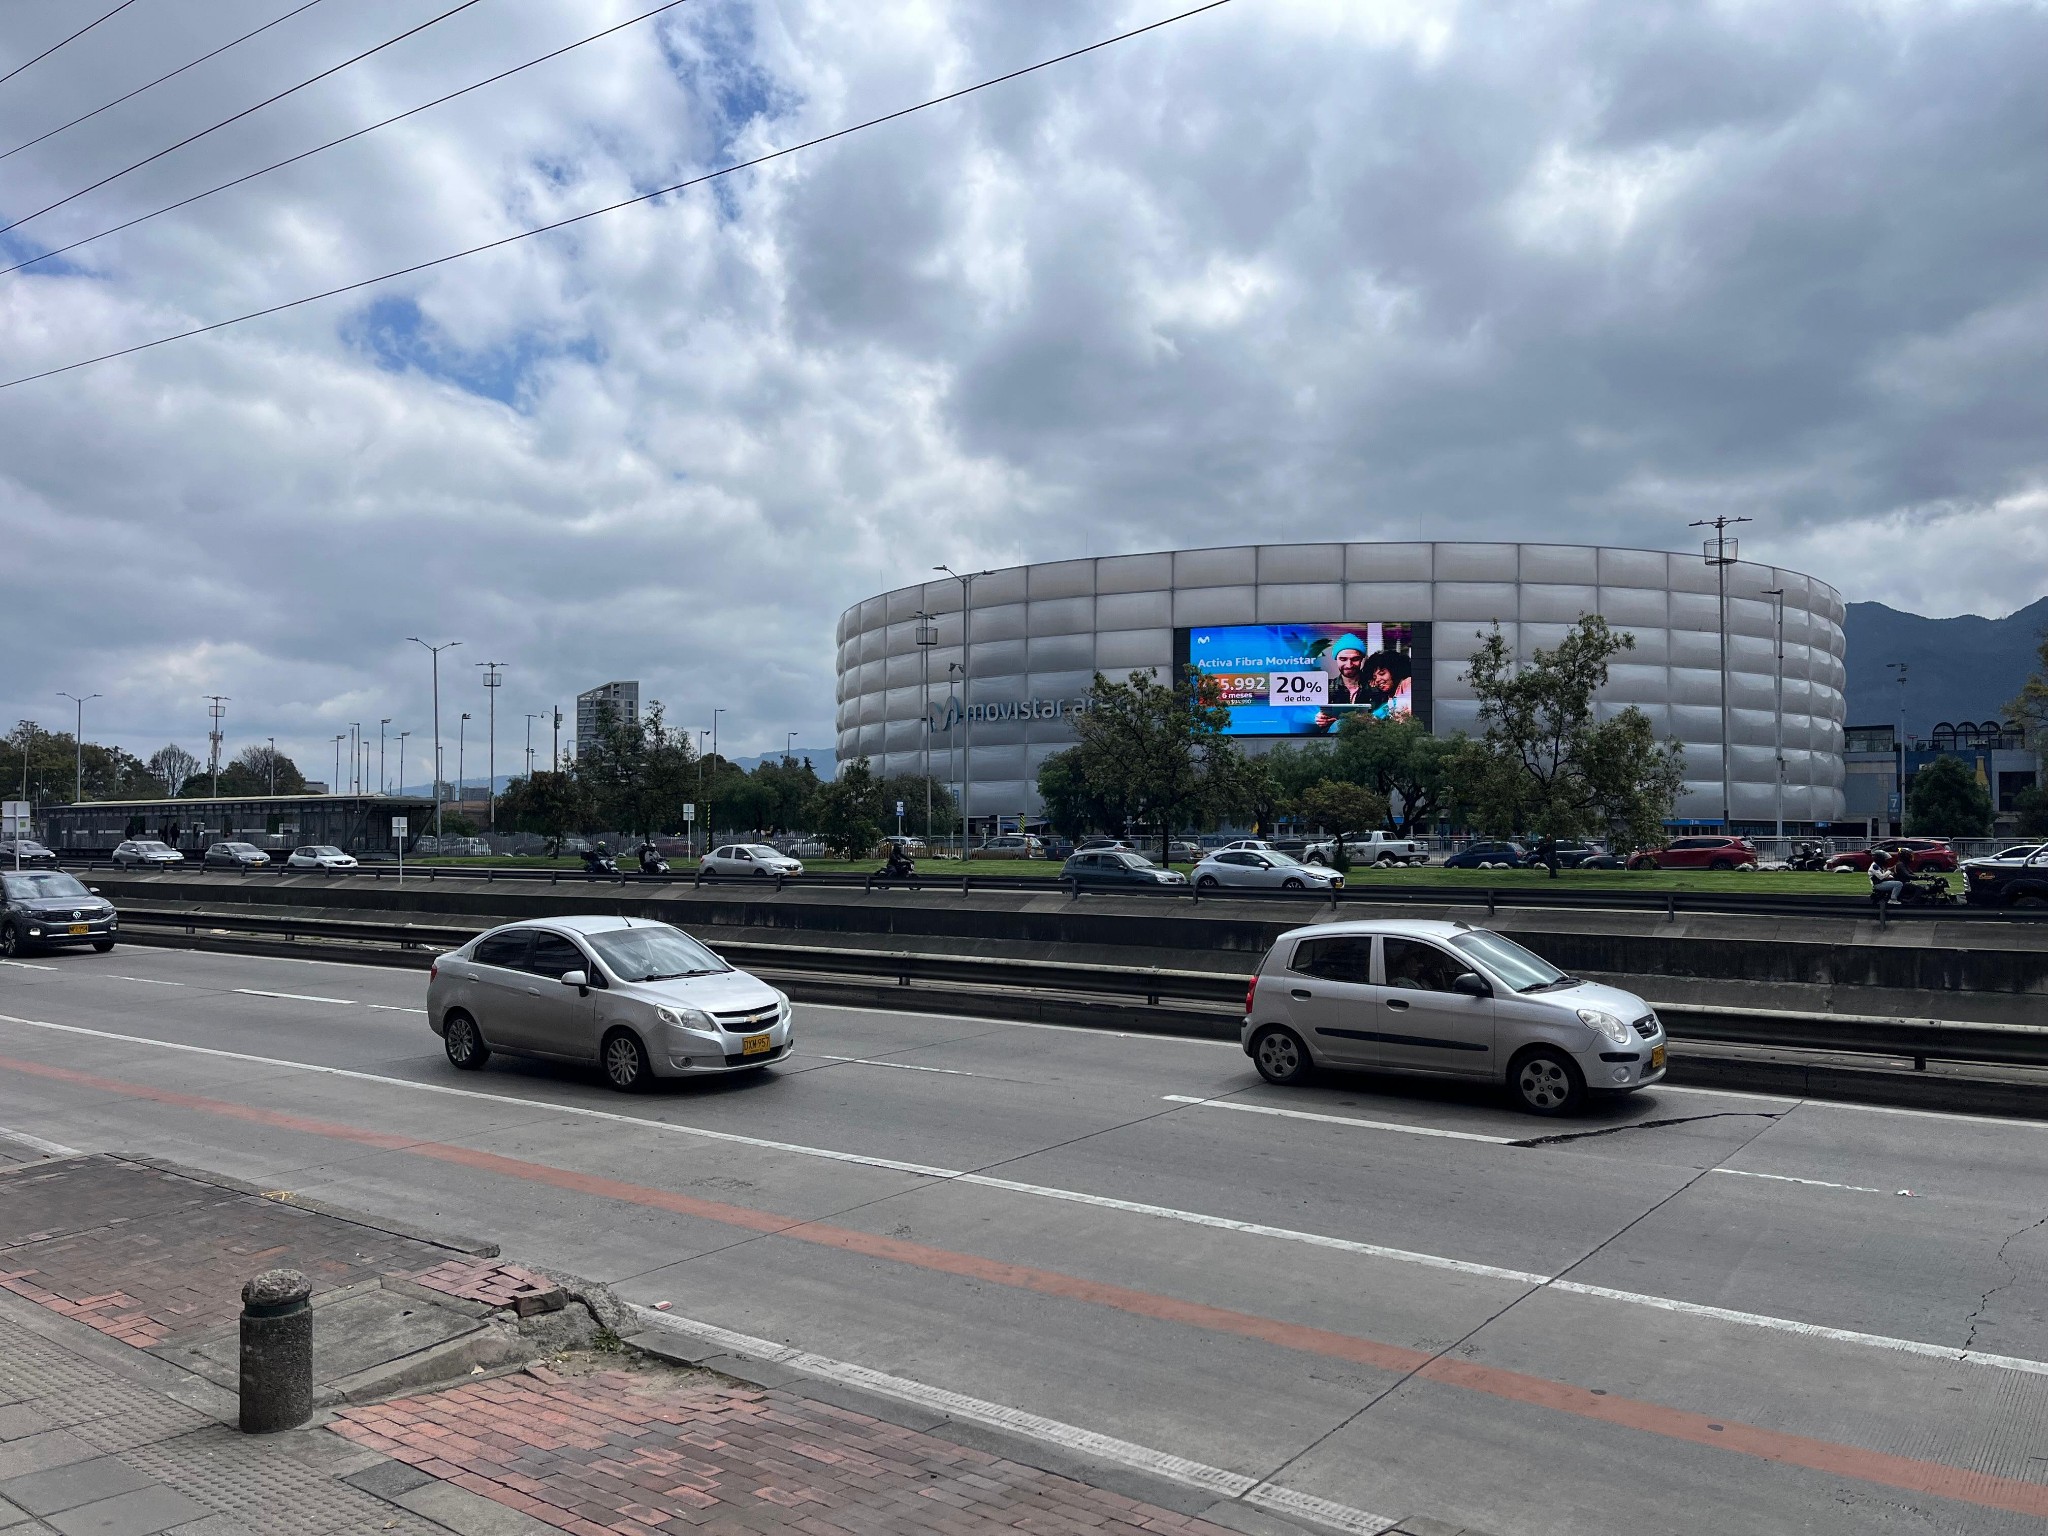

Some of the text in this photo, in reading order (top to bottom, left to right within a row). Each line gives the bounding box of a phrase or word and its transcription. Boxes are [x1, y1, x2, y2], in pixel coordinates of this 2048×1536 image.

[1198, 655, 1316, 667] Activa Fibra Movistar
[1276, 676, 1322, 693] 20%
[966, 697, 1064, 722] movistar
[1890, 798, 1898, 808] 7
